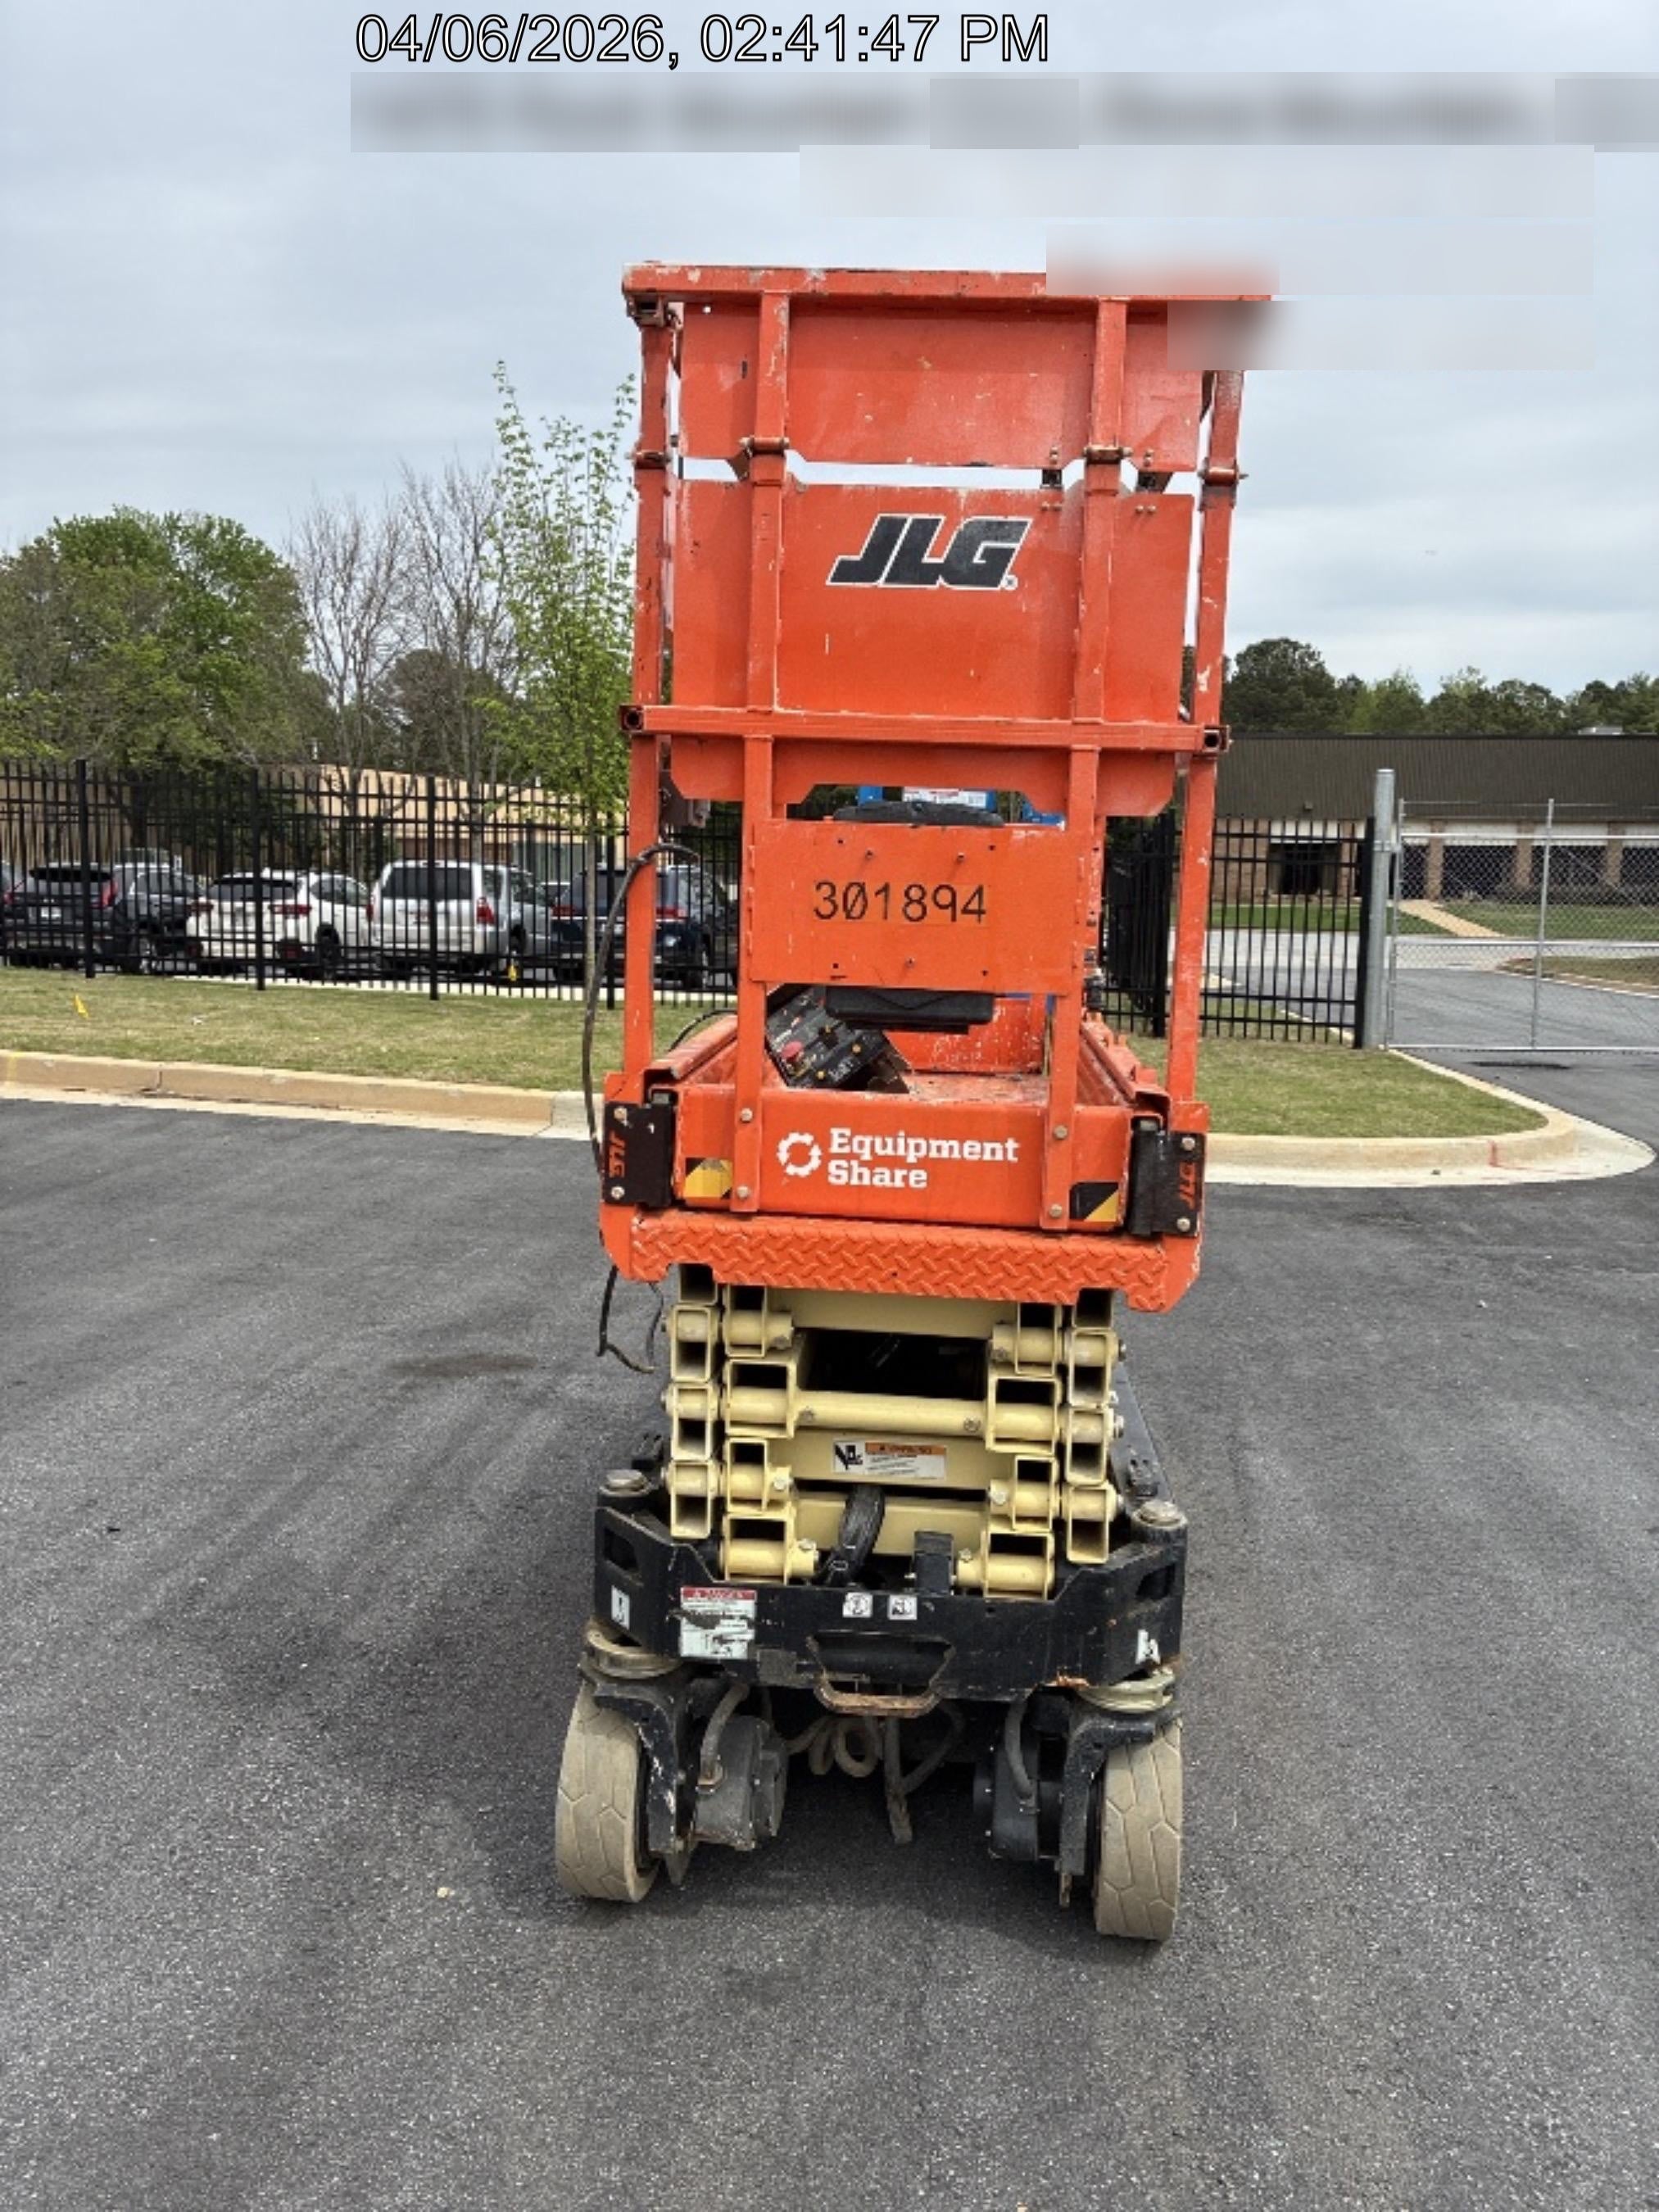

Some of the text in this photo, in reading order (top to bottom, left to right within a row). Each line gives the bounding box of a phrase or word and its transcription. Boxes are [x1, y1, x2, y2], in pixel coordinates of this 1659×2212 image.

[827, 514, 1032, 590] JLG
[813, 881, 986, 923] 301894
[829, 1127, 1021, 1163] Equipment
[827, 1159, 928, 1188] Share
